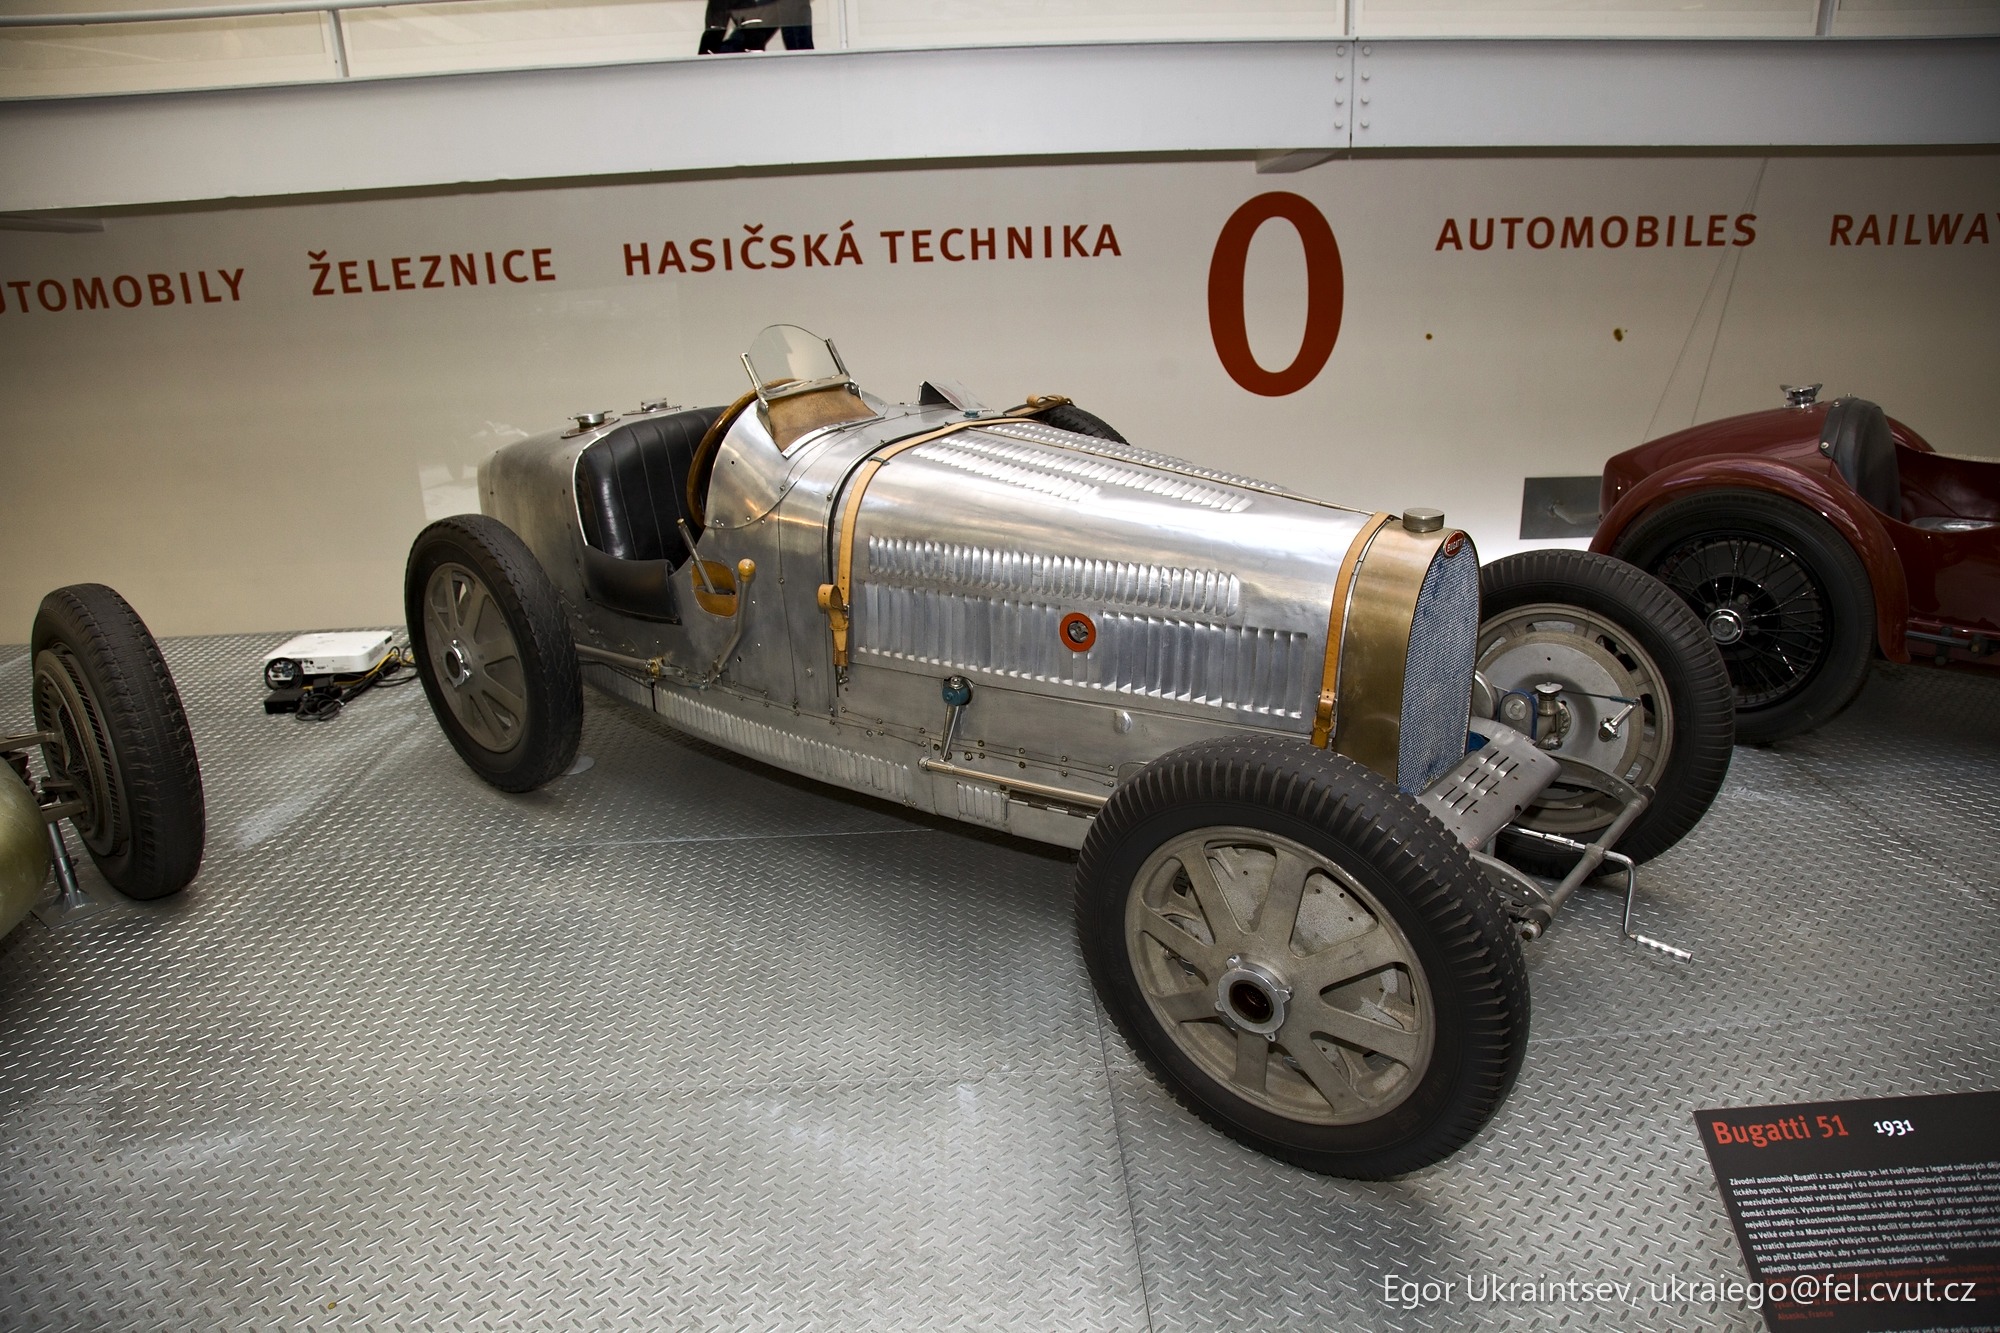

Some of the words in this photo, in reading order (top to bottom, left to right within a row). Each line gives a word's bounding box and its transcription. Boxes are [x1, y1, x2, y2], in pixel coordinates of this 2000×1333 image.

[623, 219, 863, 276] HASIČSKÁ
[880, 224, 1123, 263] TECHNIKA
[1435, 213, 1757, 251] AUTOMOBILES
[307, 248, 557, 296] ŽELEZNICE
[1712, 1115, 1811, 1148] Bugatti
[1816, 1115, 1849, 1138] 51
[1873, 1119, 1915, 1137] 1931
[1729, 1177, 1756, 1186] Závodní
[1757, 1175, 1793, 1184] automobily
[1793, 1173, 1818, 1182] Bugatti
[1841, 1170, 1867, 1179] počátku
